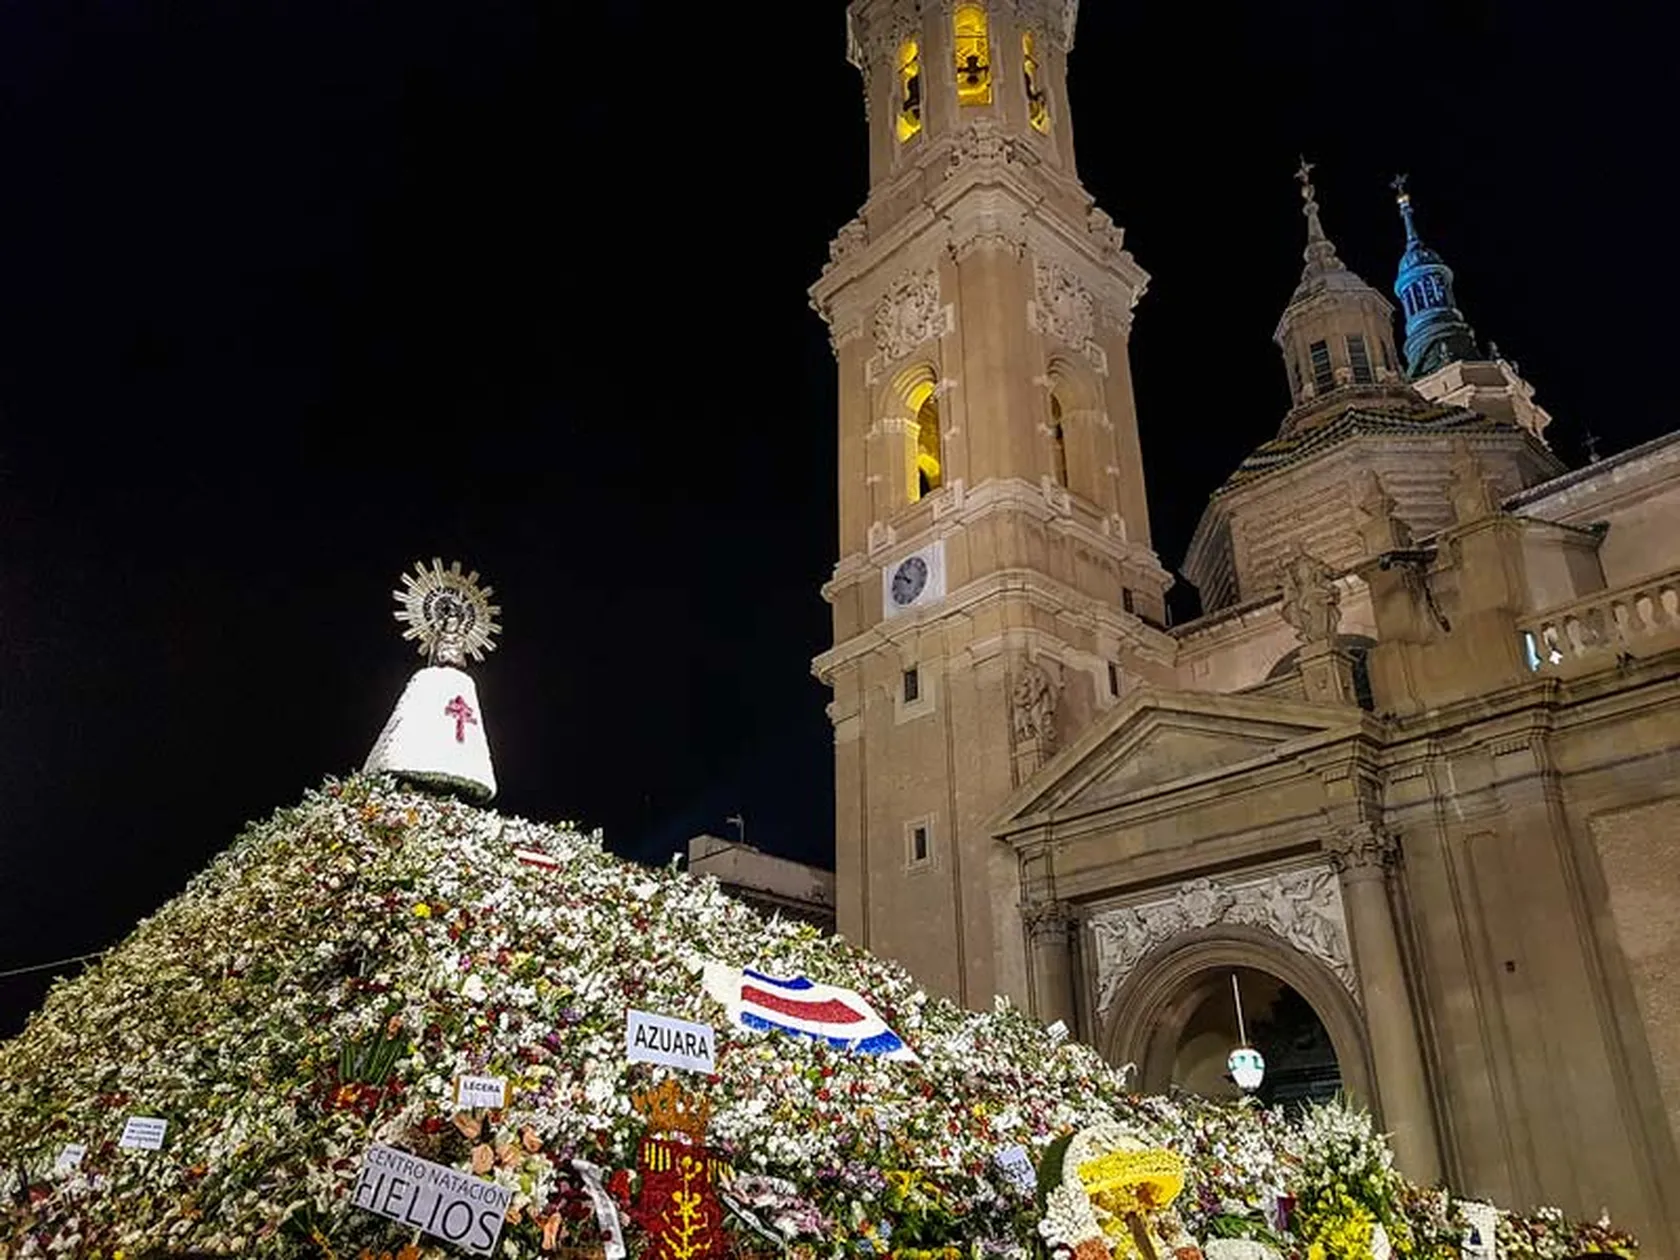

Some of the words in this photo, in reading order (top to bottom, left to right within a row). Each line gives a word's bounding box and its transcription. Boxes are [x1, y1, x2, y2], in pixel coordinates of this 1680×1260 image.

[634, 1023, 710, 1060] AZUARA
[366, 1147, 426, 1179] CENTRO
[428, 1168, 509, 1208] NATACIÓN
[355, 1168, 499, 1250] HELIOS
